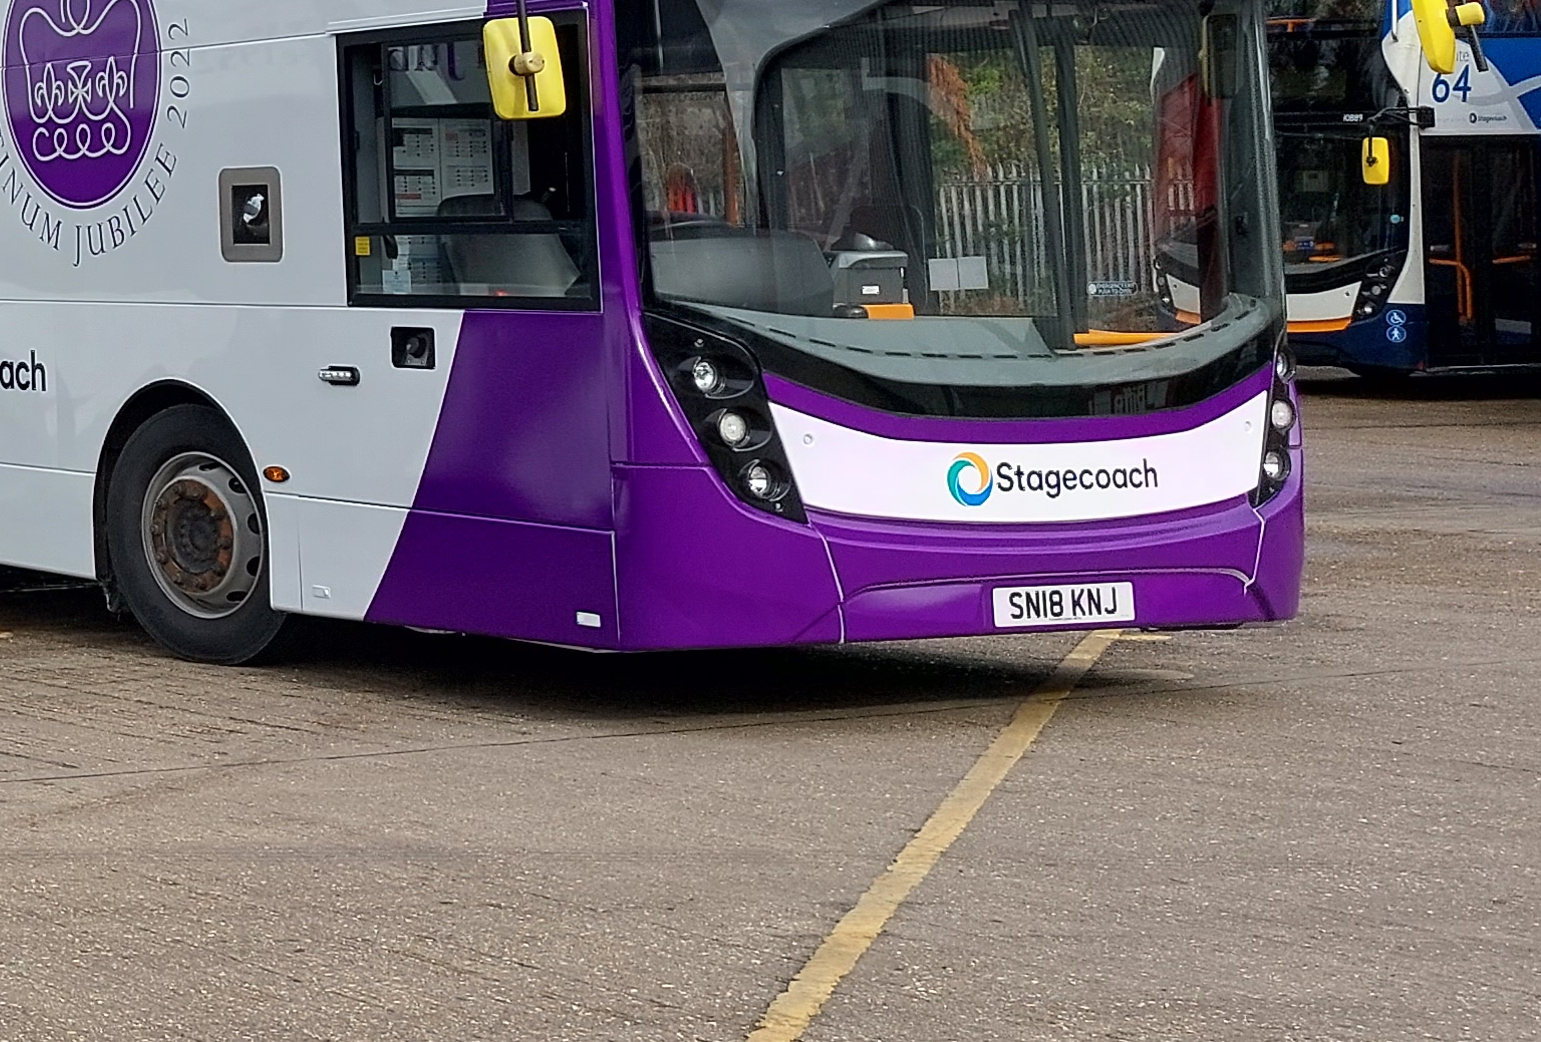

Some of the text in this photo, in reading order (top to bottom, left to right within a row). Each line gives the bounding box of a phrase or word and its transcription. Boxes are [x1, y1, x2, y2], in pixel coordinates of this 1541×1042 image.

[1432, 64, 1471, 103] 64
[73, 142, 178, 267] JUBILEE
[166, 18, 192, 129] 2022
[996, 458, 1158, 499] Stagecoach
[1009, 586, 1117, 620] SN18 KNJ
